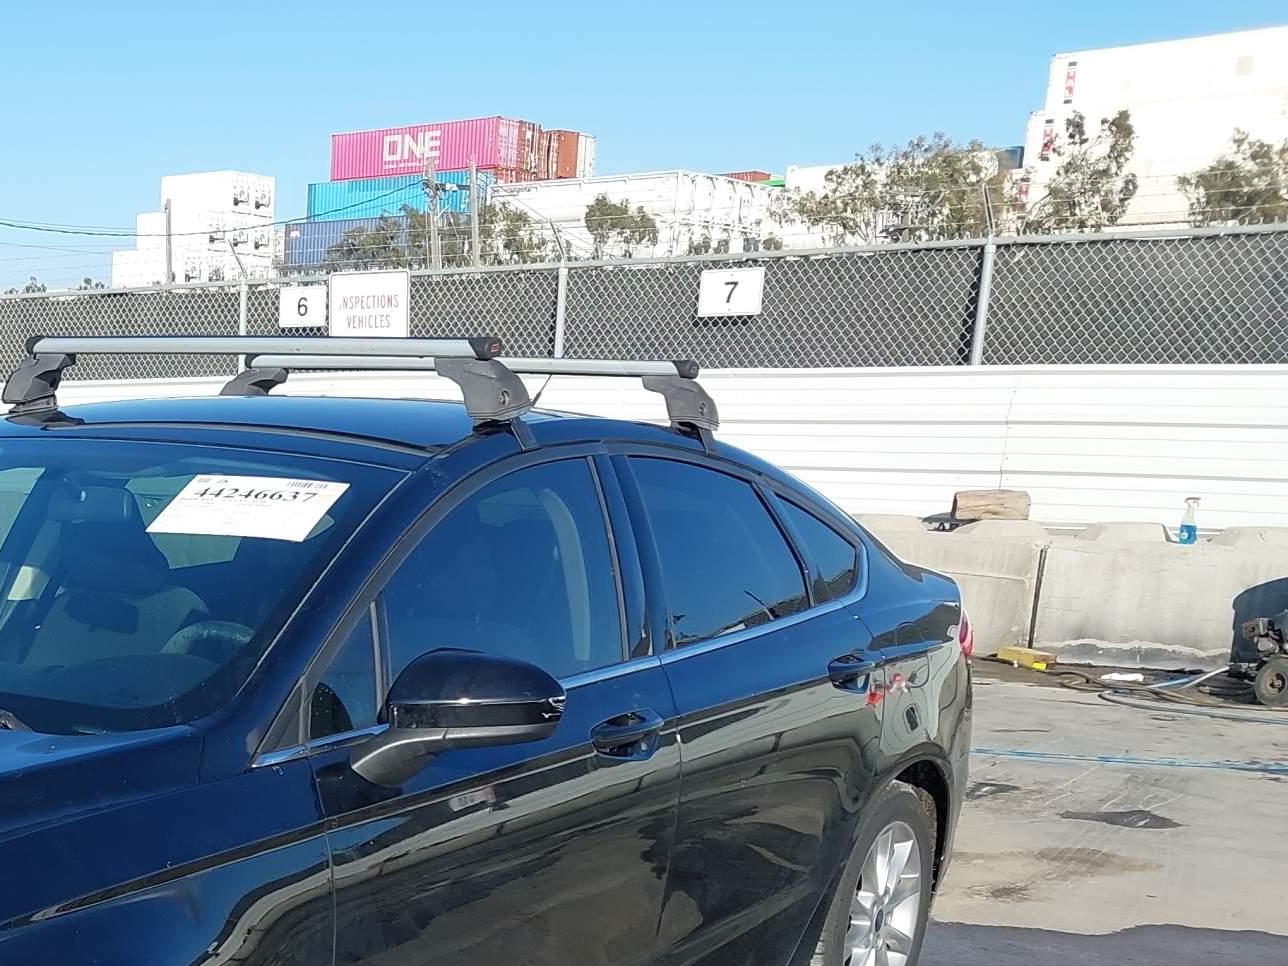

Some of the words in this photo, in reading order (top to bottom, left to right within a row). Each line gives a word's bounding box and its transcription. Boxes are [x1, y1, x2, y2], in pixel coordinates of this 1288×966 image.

[383, 130, 441, 161] ONE
[724, 281, 739, 303] 7
[297, 297, 308, 316] 6
[339, 294, 399, 310] INSPECTIONS
[346, 314, 391, 329] VEHICLES
[193, 486, 319, 503] 44246637
